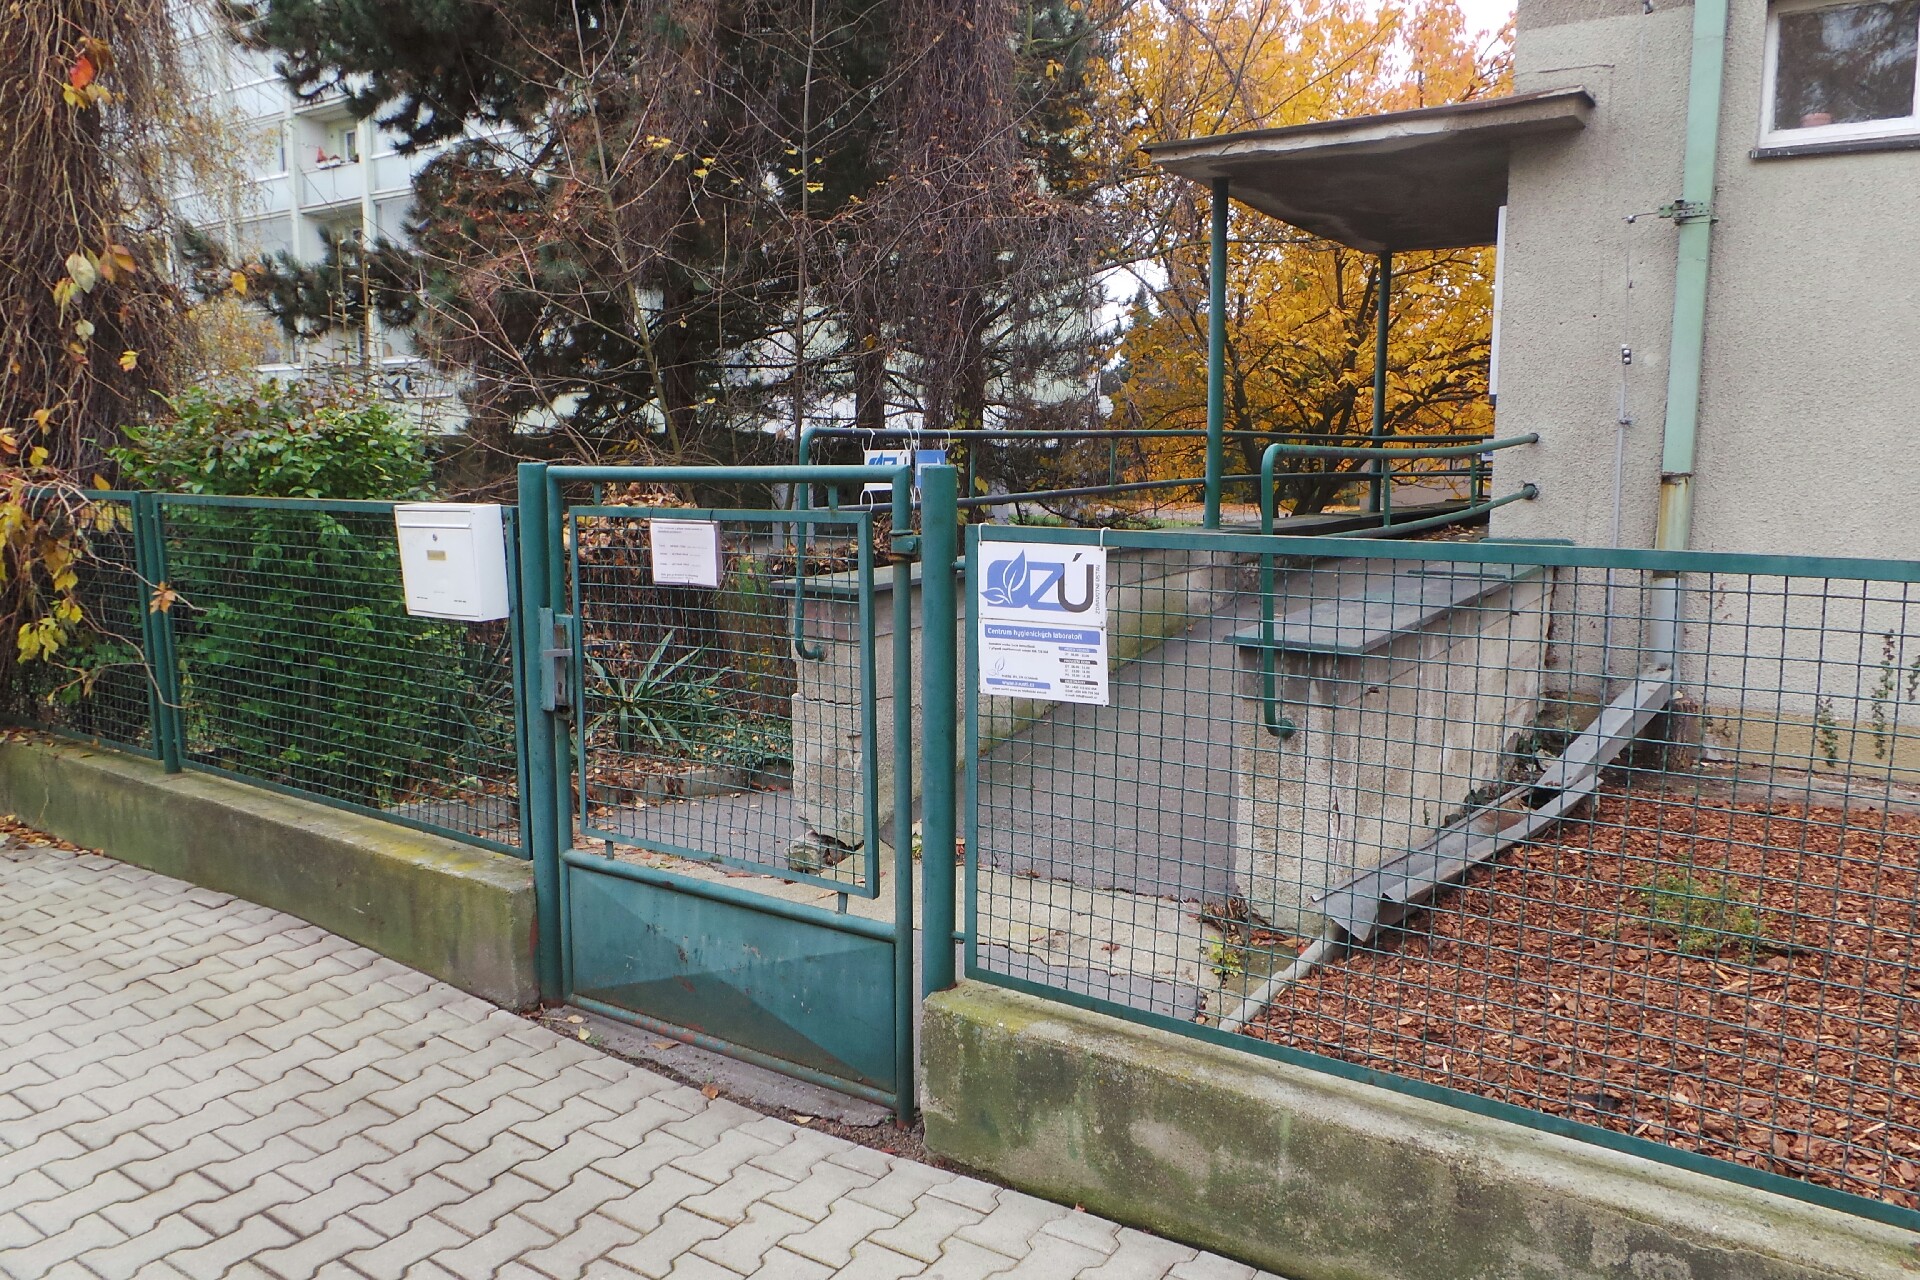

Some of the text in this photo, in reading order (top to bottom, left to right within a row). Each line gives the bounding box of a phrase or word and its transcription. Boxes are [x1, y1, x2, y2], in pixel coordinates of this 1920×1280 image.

[987, 627, 1083, 641] Centrum hygienických laboratoří
